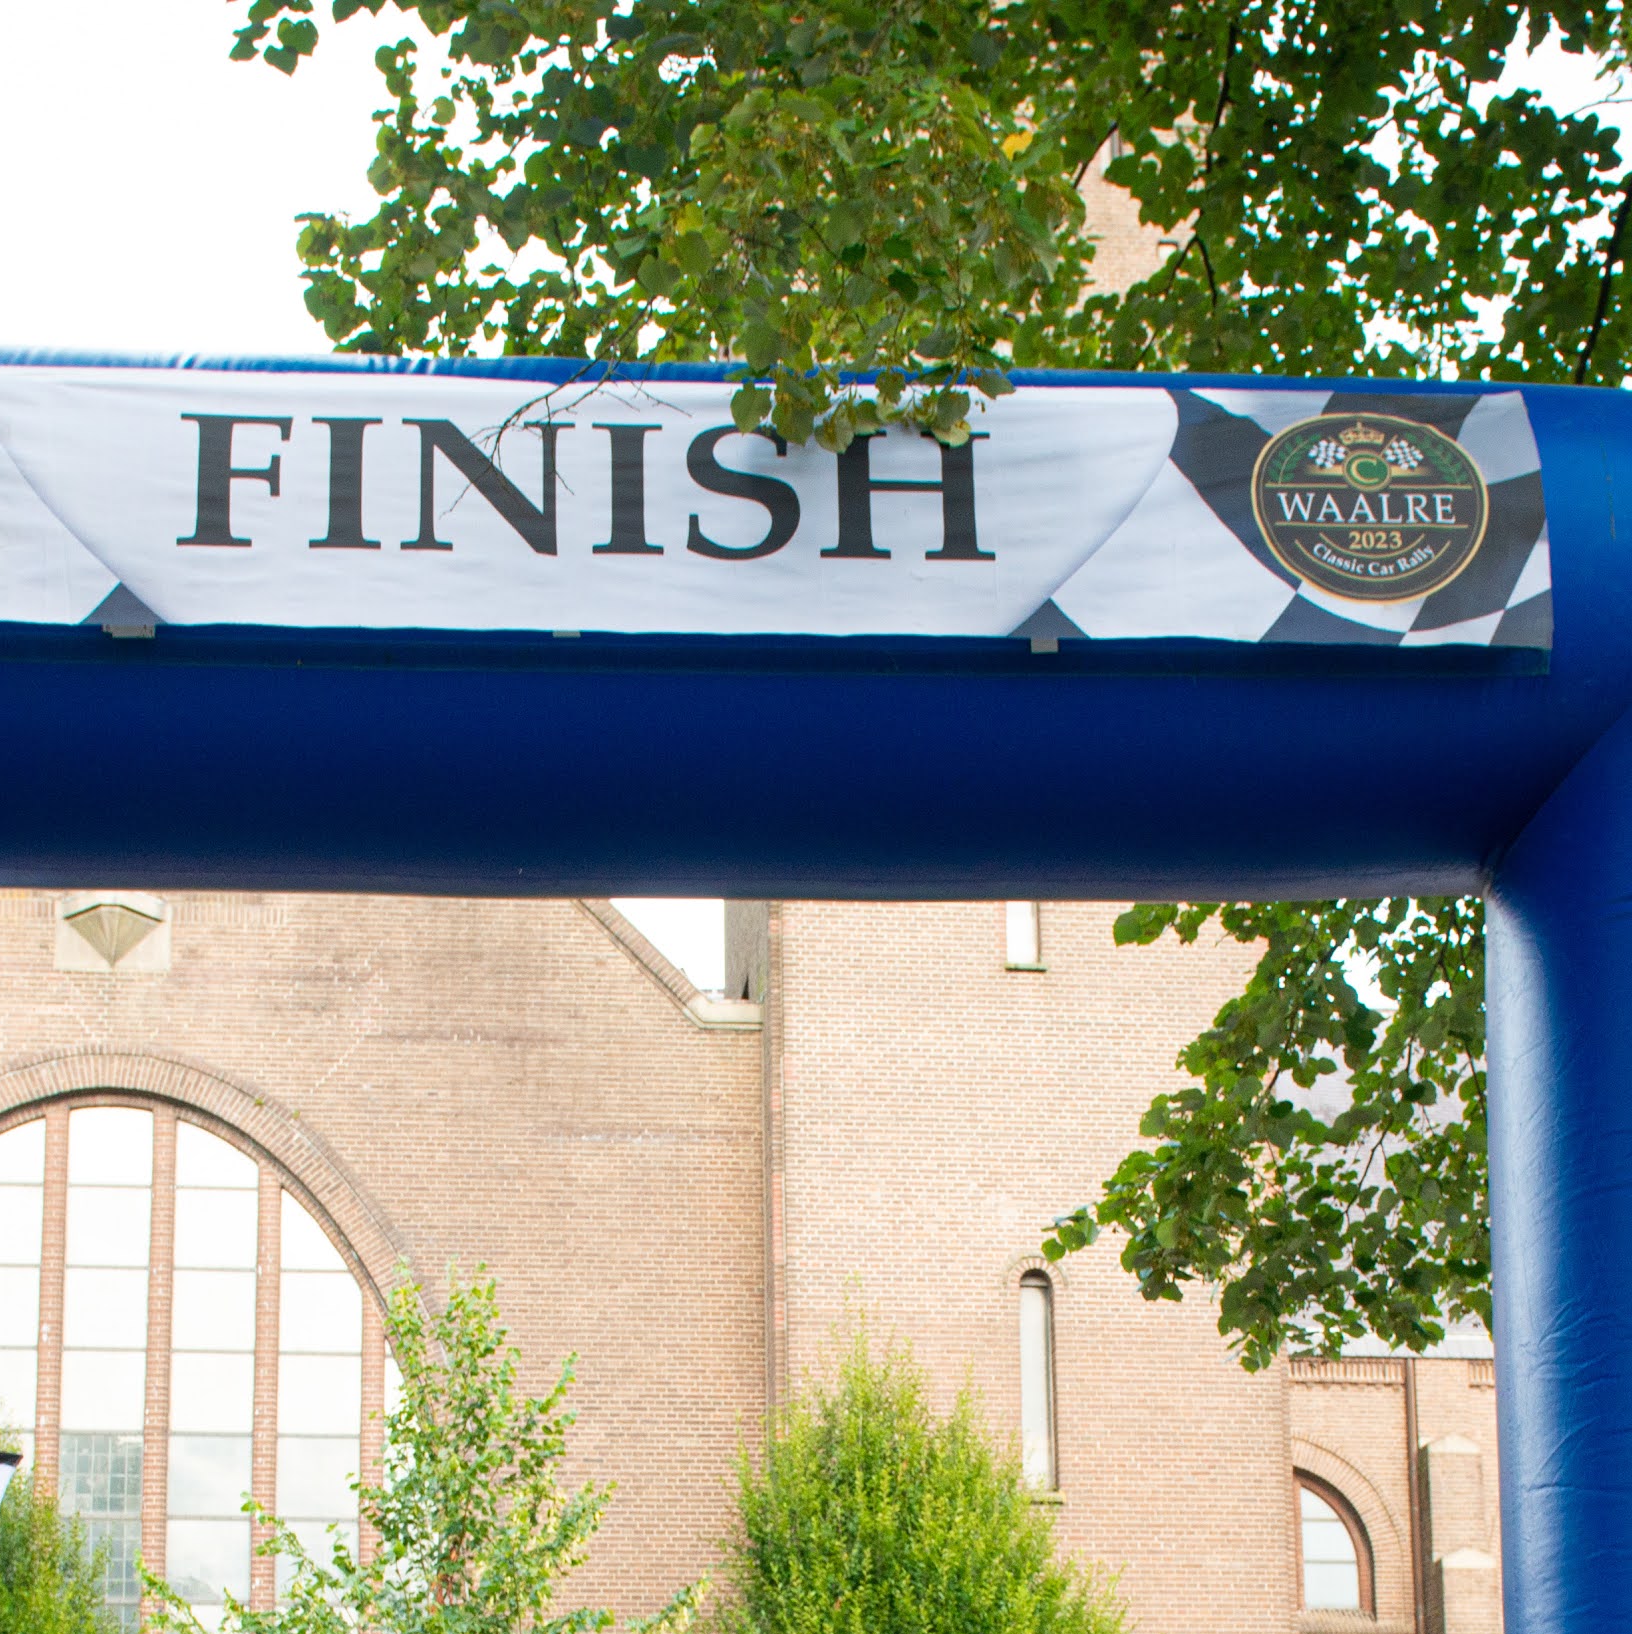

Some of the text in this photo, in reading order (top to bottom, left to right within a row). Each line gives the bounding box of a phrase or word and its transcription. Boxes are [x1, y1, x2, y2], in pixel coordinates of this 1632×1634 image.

[176, 413, 996, 561] FINISH
[1350, 458, 1379, 484] C
[1277, 492, 1456, 524] WAALRE
[1348, 530, 1403, 550] 2023
[1312, 543, 1435, 576] Classic Car Rally
